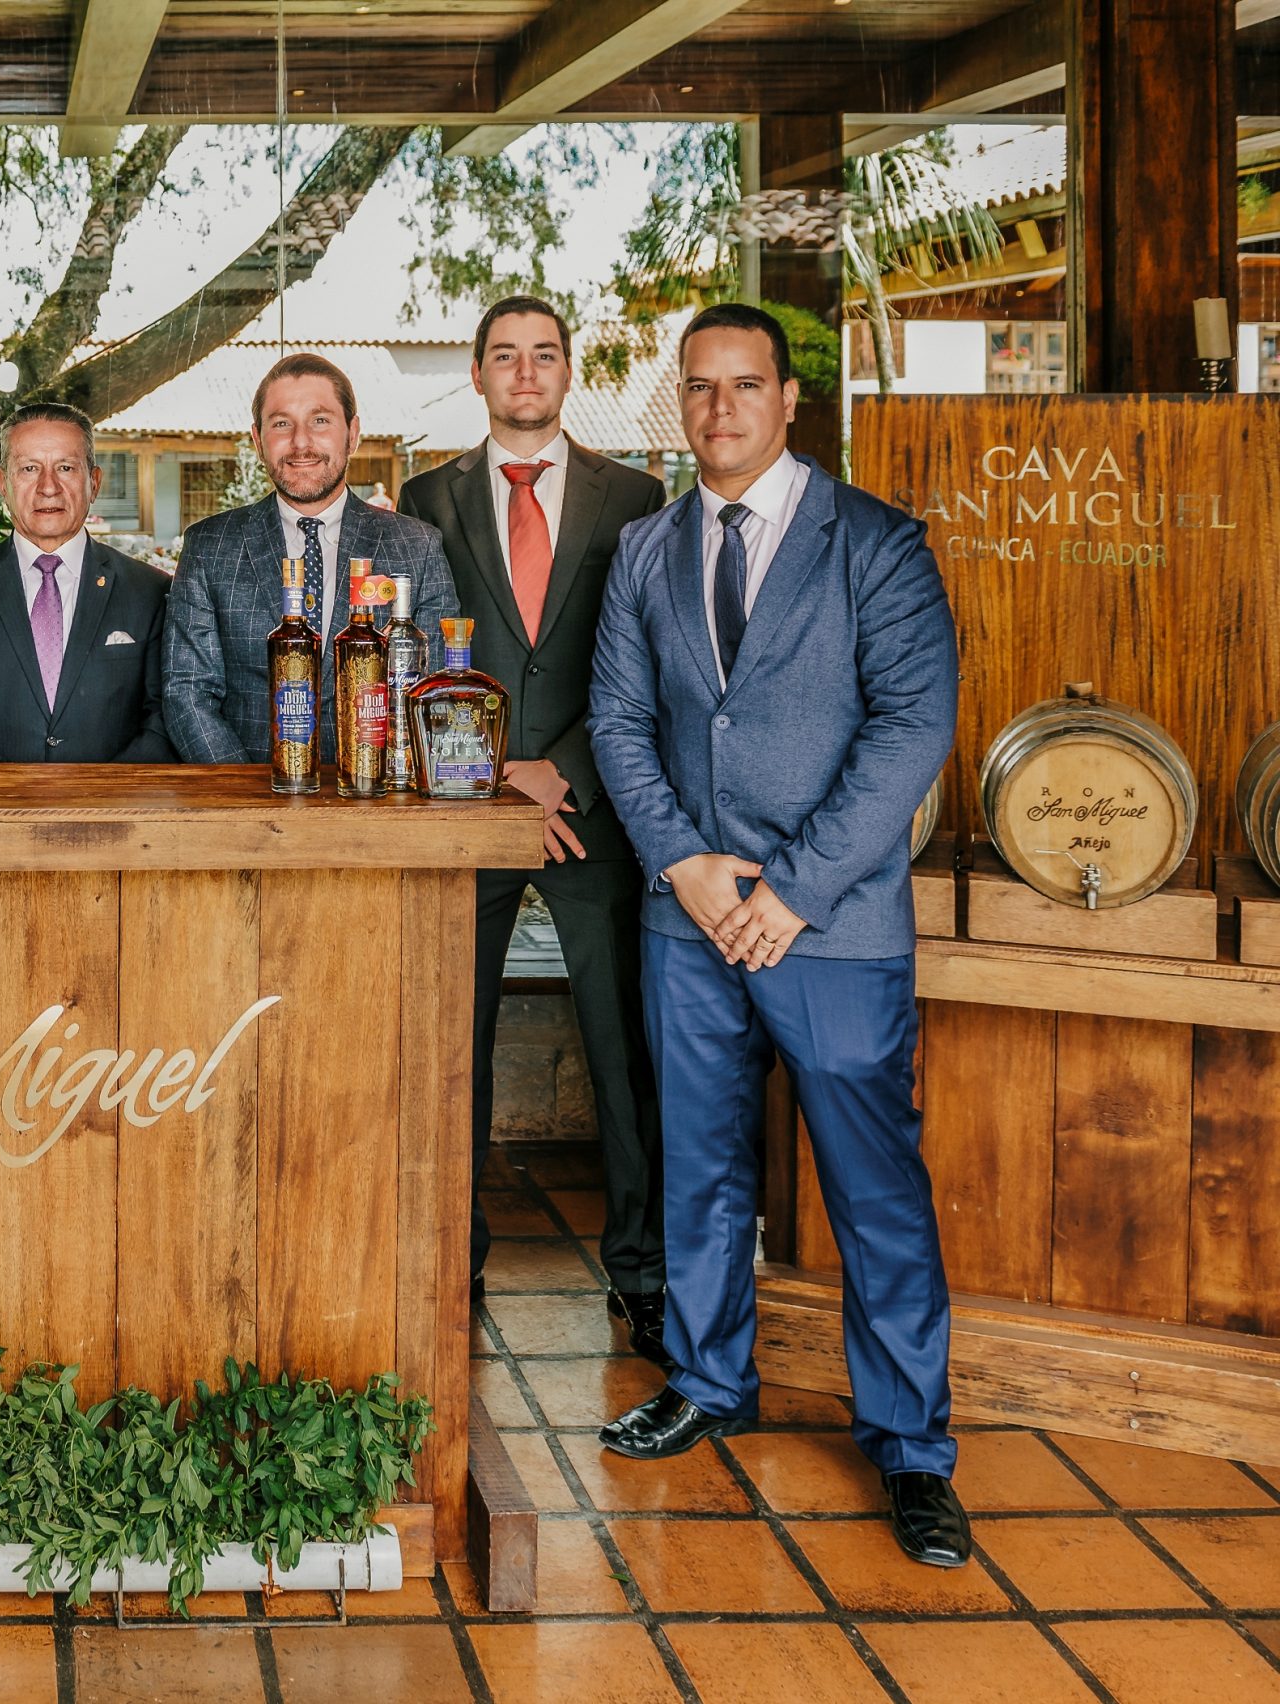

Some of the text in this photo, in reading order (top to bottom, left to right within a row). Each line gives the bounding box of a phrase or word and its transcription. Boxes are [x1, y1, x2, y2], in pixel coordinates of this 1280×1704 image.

[981, 446, 1126, 482] CAVA
[895, 487, 1236, 529] SAN MIGUEL
[946, 535, 1036, 562] CUENCA
[1060, 539, 1167, 568] ECUADOR
[392, 674, 419, 687] Miguel
[284, 691, 307, 704] DON
[364, 693, 384, 707] DON
[280, 704, 312, 715] MIGUEL
[359, 706, 387, 718] MIGUEL
[431, 747, 494, 757] SOLERA
[1040, 786, 1135, 799] RON
[1027, 797, 1148, 825] San Miguel
[1068, 836, 1111, 851] Añejo
